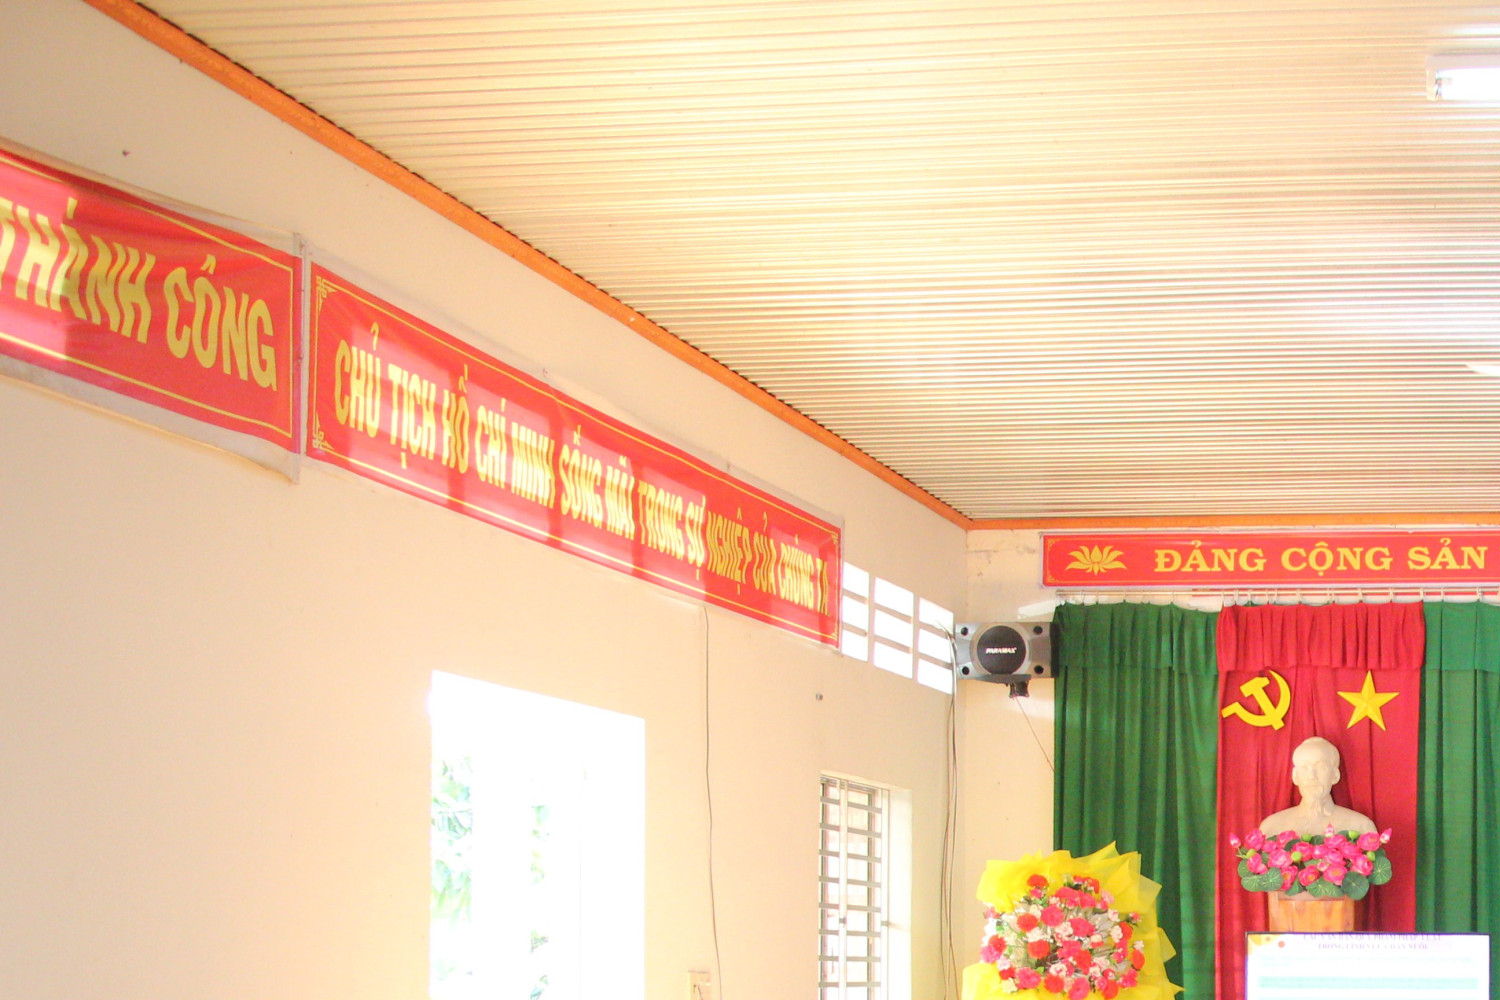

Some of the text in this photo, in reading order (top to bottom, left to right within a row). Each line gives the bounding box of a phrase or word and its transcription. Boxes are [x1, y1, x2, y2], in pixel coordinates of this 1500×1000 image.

[163, 254, 278, 392] CÔNG
[335, 322, 830, 616] CHỦ TỊCH HỒ CHÍ MINH SỐNG MÃI TRONG SỰ NGHIỆP CỦA CHÚNG TA
[1154, 540, 1268, 574] ĐẢNG
[1281, 540, 1394, 577] CỘNG
[1407, 537, 1488, 571] SẢN
